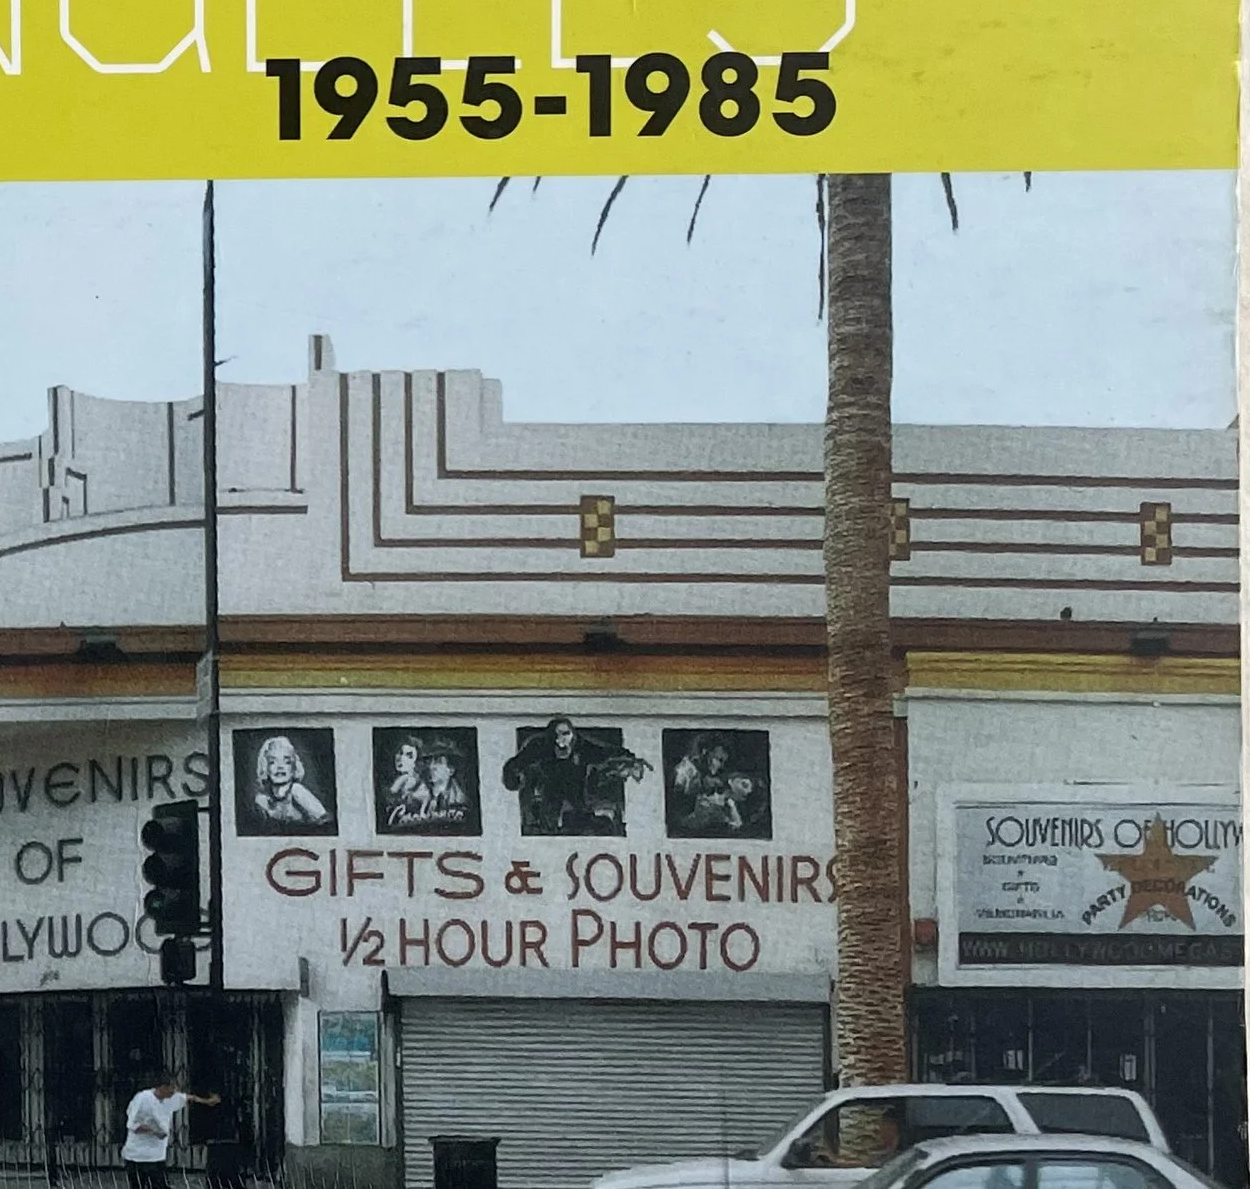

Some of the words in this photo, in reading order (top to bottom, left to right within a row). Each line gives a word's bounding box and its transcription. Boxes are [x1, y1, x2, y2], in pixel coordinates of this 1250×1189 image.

[266, 51, 837, 141] 1955-1985
[985, 816, 1104, 850] SOUVENIRS
[15, 837, 84, 885] OF
[265, 847, 485, 900] GIFTS
[505, 861, 543, 896] &
[1082, 884, 1126, 926] PARTY
[399, 918, 549, 969] HOUR
[571, 909, 761, 972] PHOTO
